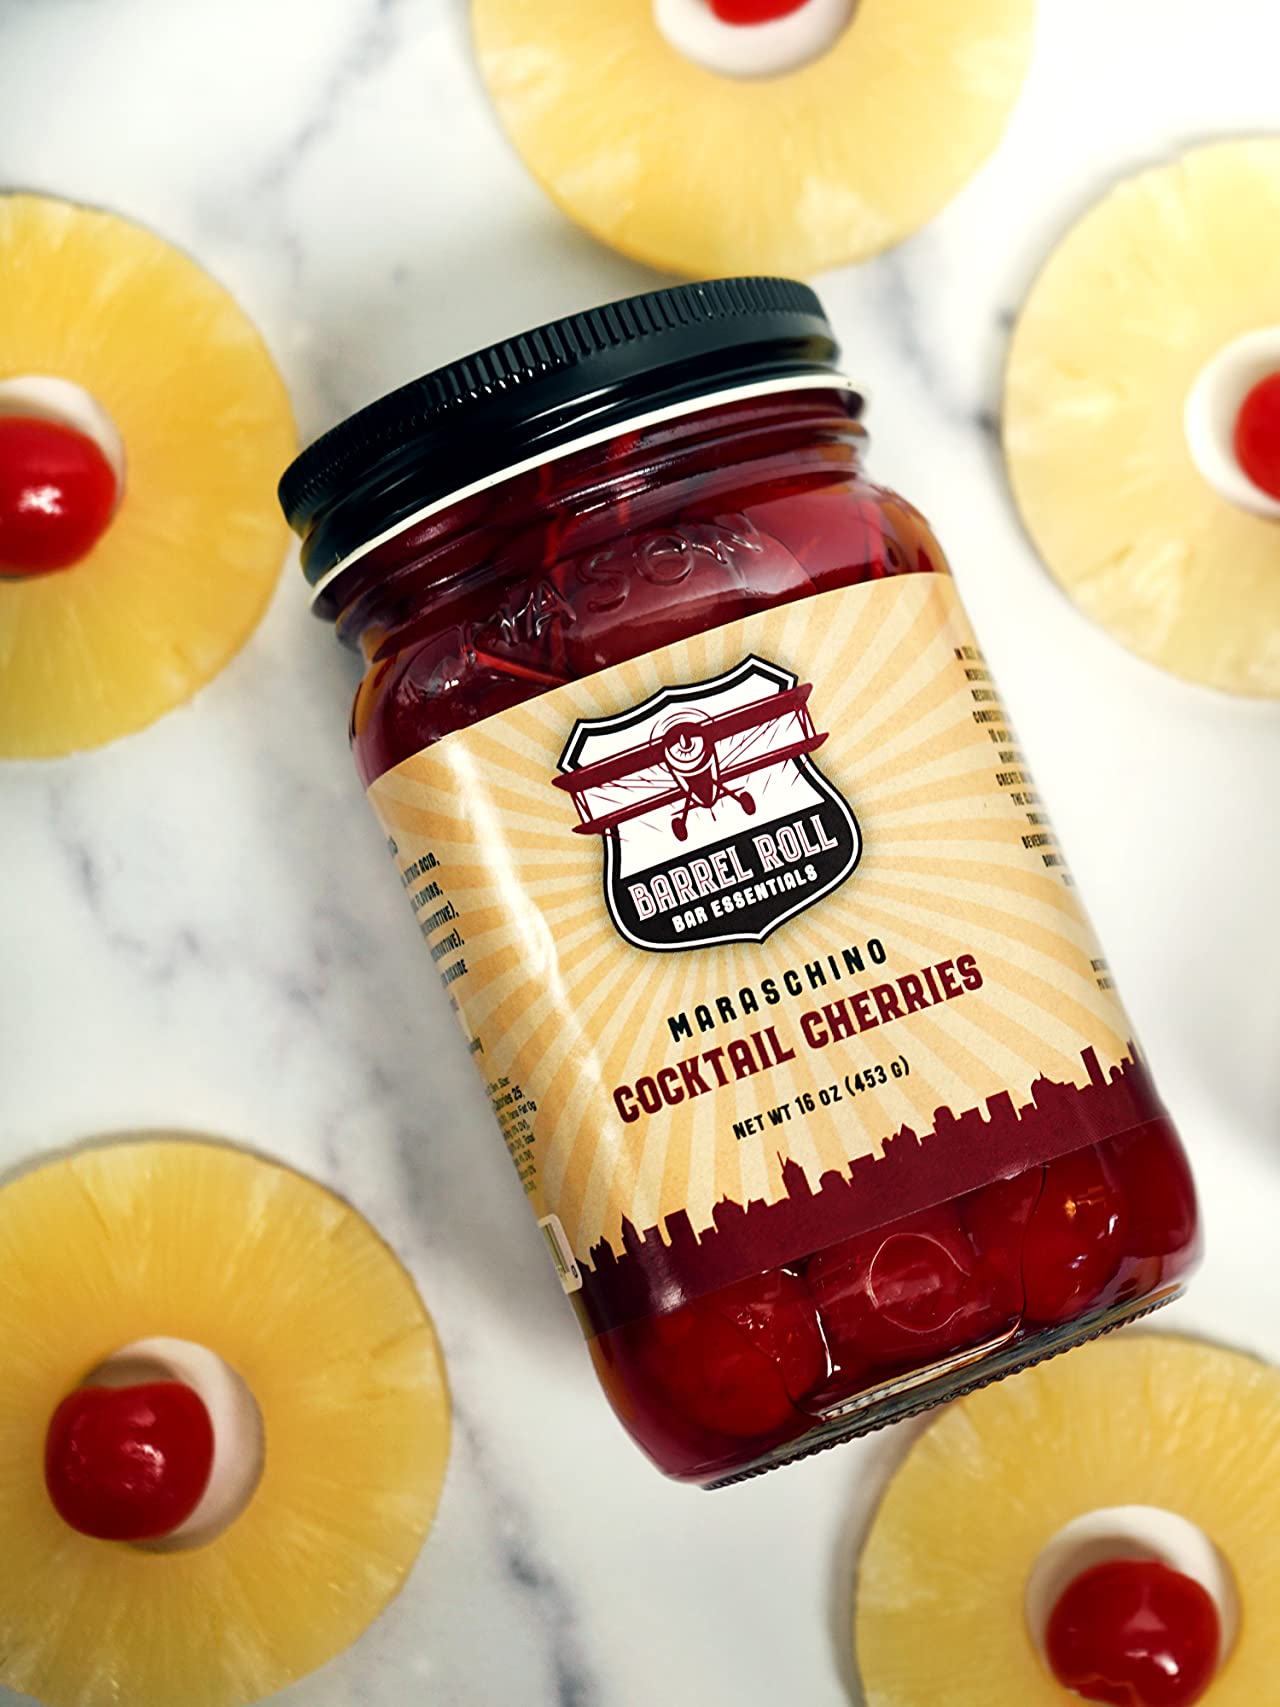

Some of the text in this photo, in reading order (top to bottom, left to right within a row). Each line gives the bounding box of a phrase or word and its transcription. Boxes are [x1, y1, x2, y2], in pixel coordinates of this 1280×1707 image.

[628, 814, 839, 921] BARREL ROLL
[671, 863, 818, 933] BAR ESSENTIALS
[613, 953, 984, 1124] COCKTAIL CHERRIES
[667, 938, 887, 1042] MARASCHINO
[732, 1114, 765, 1140] NET
[768, 1103, 792, 1126] WT
[795, 1092, 816, 1115] 16
[844, 1065, 888, 1098] (453
